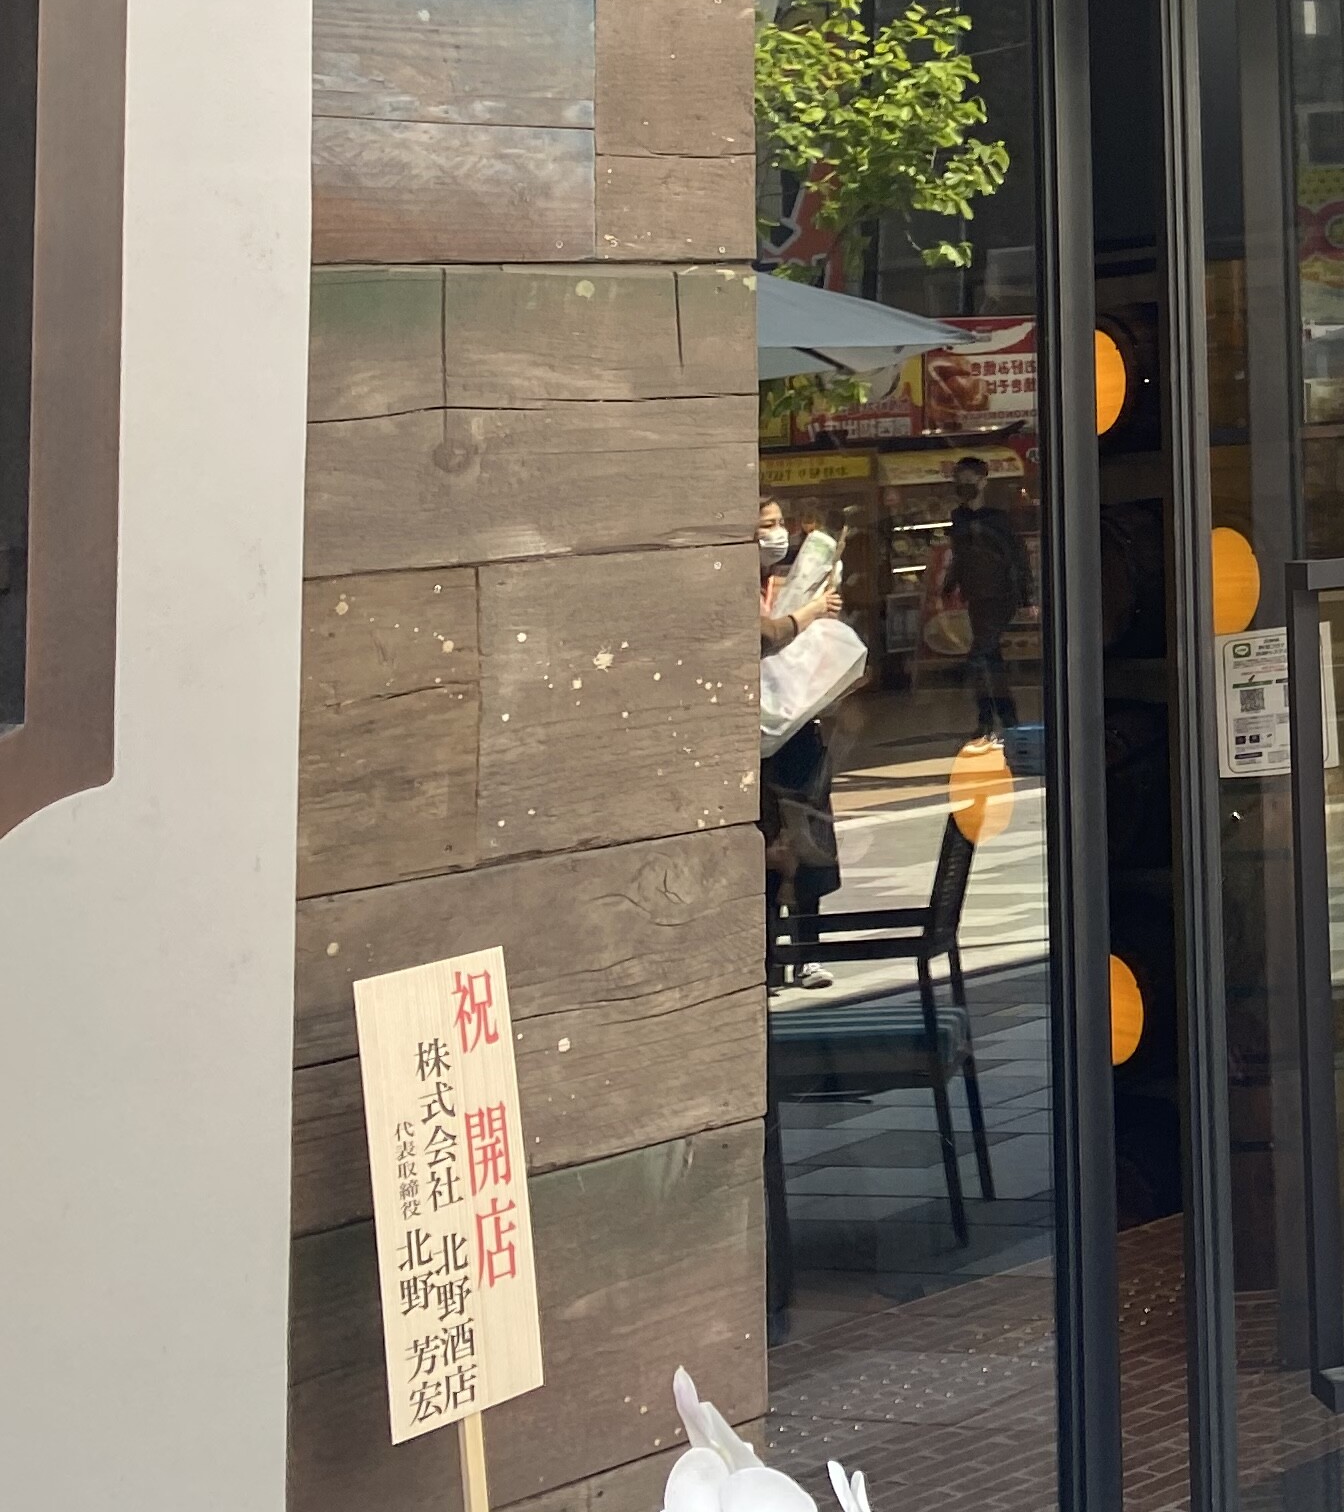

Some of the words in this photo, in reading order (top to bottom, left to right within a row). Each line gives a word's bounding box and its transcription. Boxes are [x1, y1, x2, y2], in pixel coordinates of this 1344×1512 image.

[451, 969, 500, 1055] 祝
[394, 1121, 422, 1221] 代表取締役
[413, 1037, 465, 1213] 株式会社
[463, 1099, 518, 1290] 開店
[396, 1227, 436, 1317] 北野
[432, 1232, 478, 1414] 北野酒店
